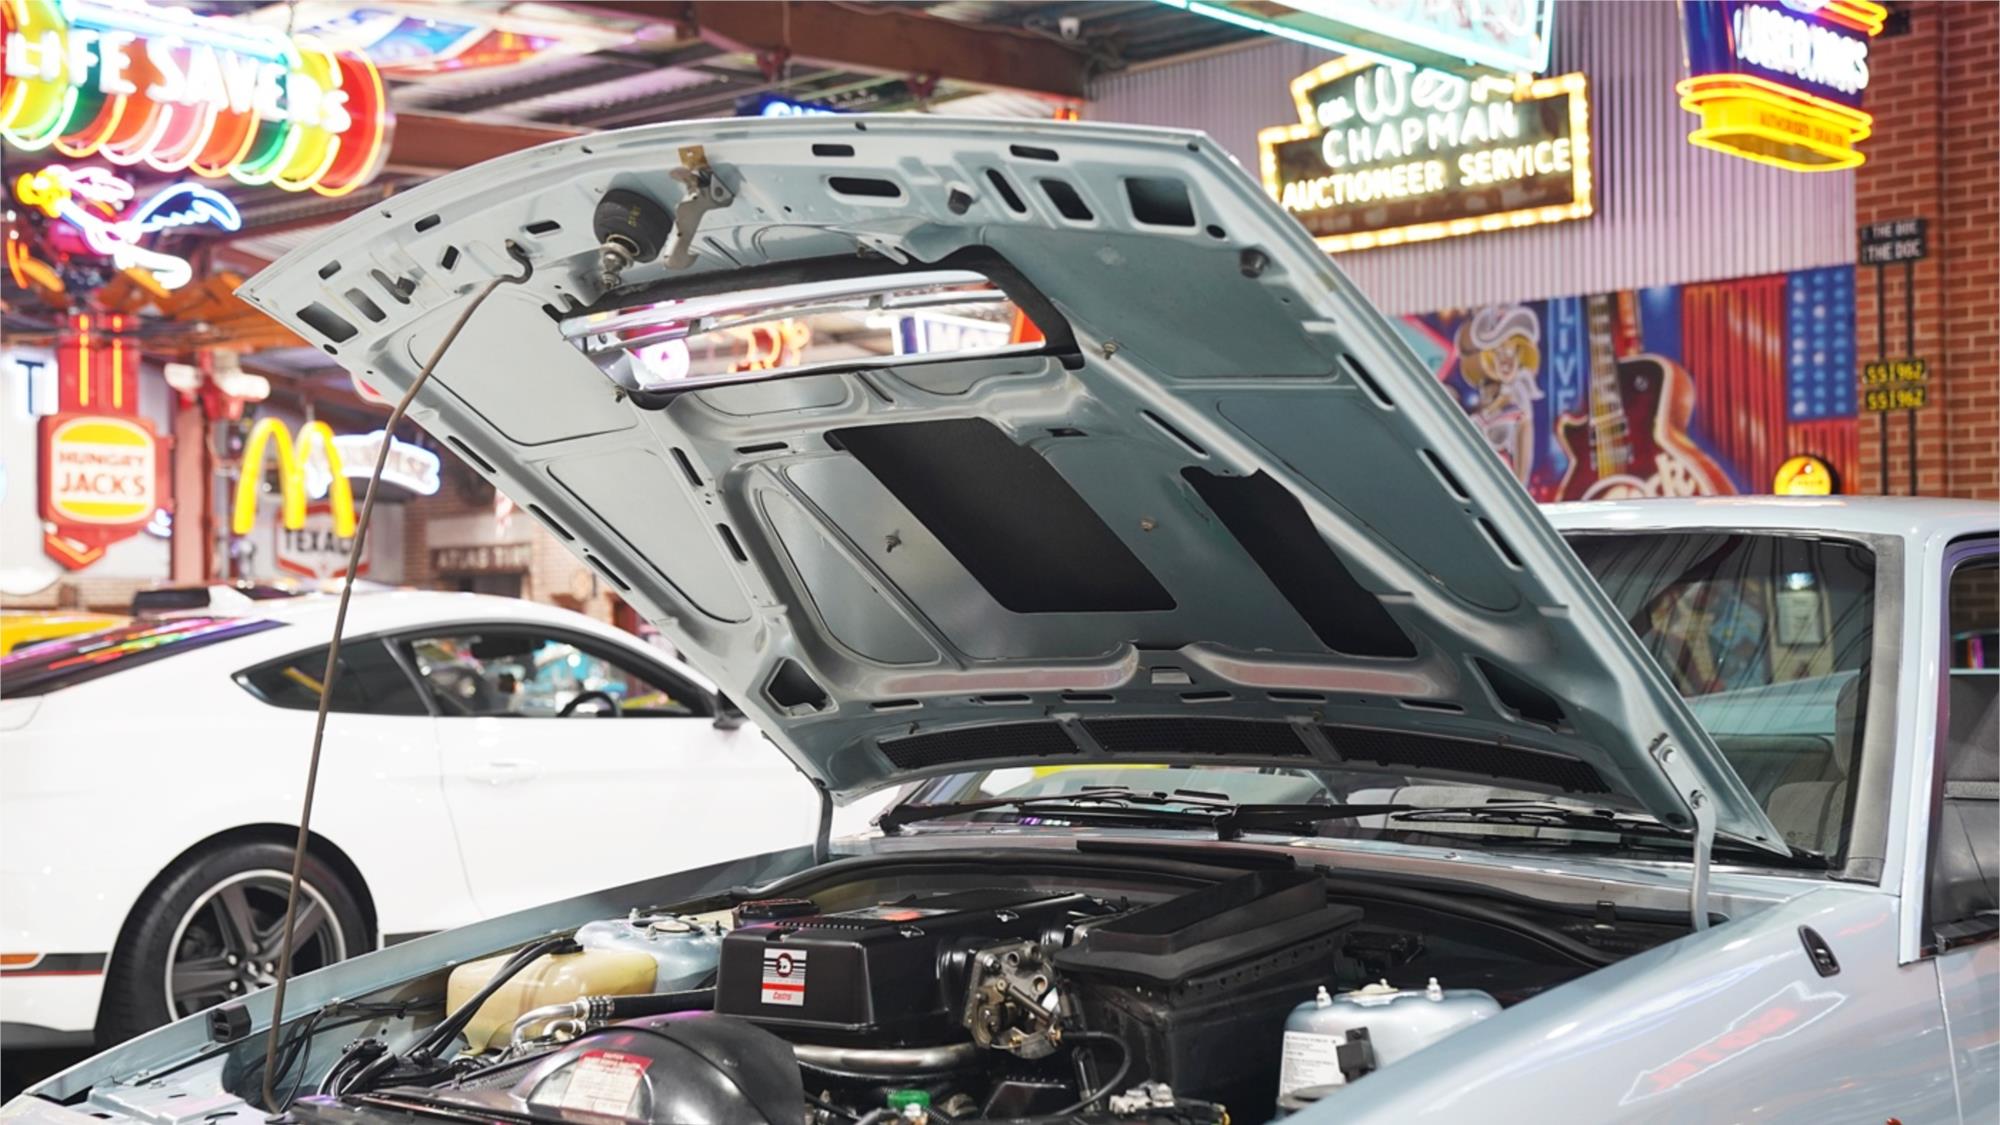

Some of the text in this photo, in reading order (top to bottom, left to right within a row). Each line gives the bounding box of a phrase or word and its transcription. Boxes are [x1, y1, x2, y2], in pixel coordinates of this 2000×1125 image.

[6, 30, 137, 95] LIFE
[1321, 100, 1520, 169] CHAPMAN
[1281, 137, 1572, 213] AUCTIONEER SERVICE
[59, 451, 144, 467] HUNGRY
